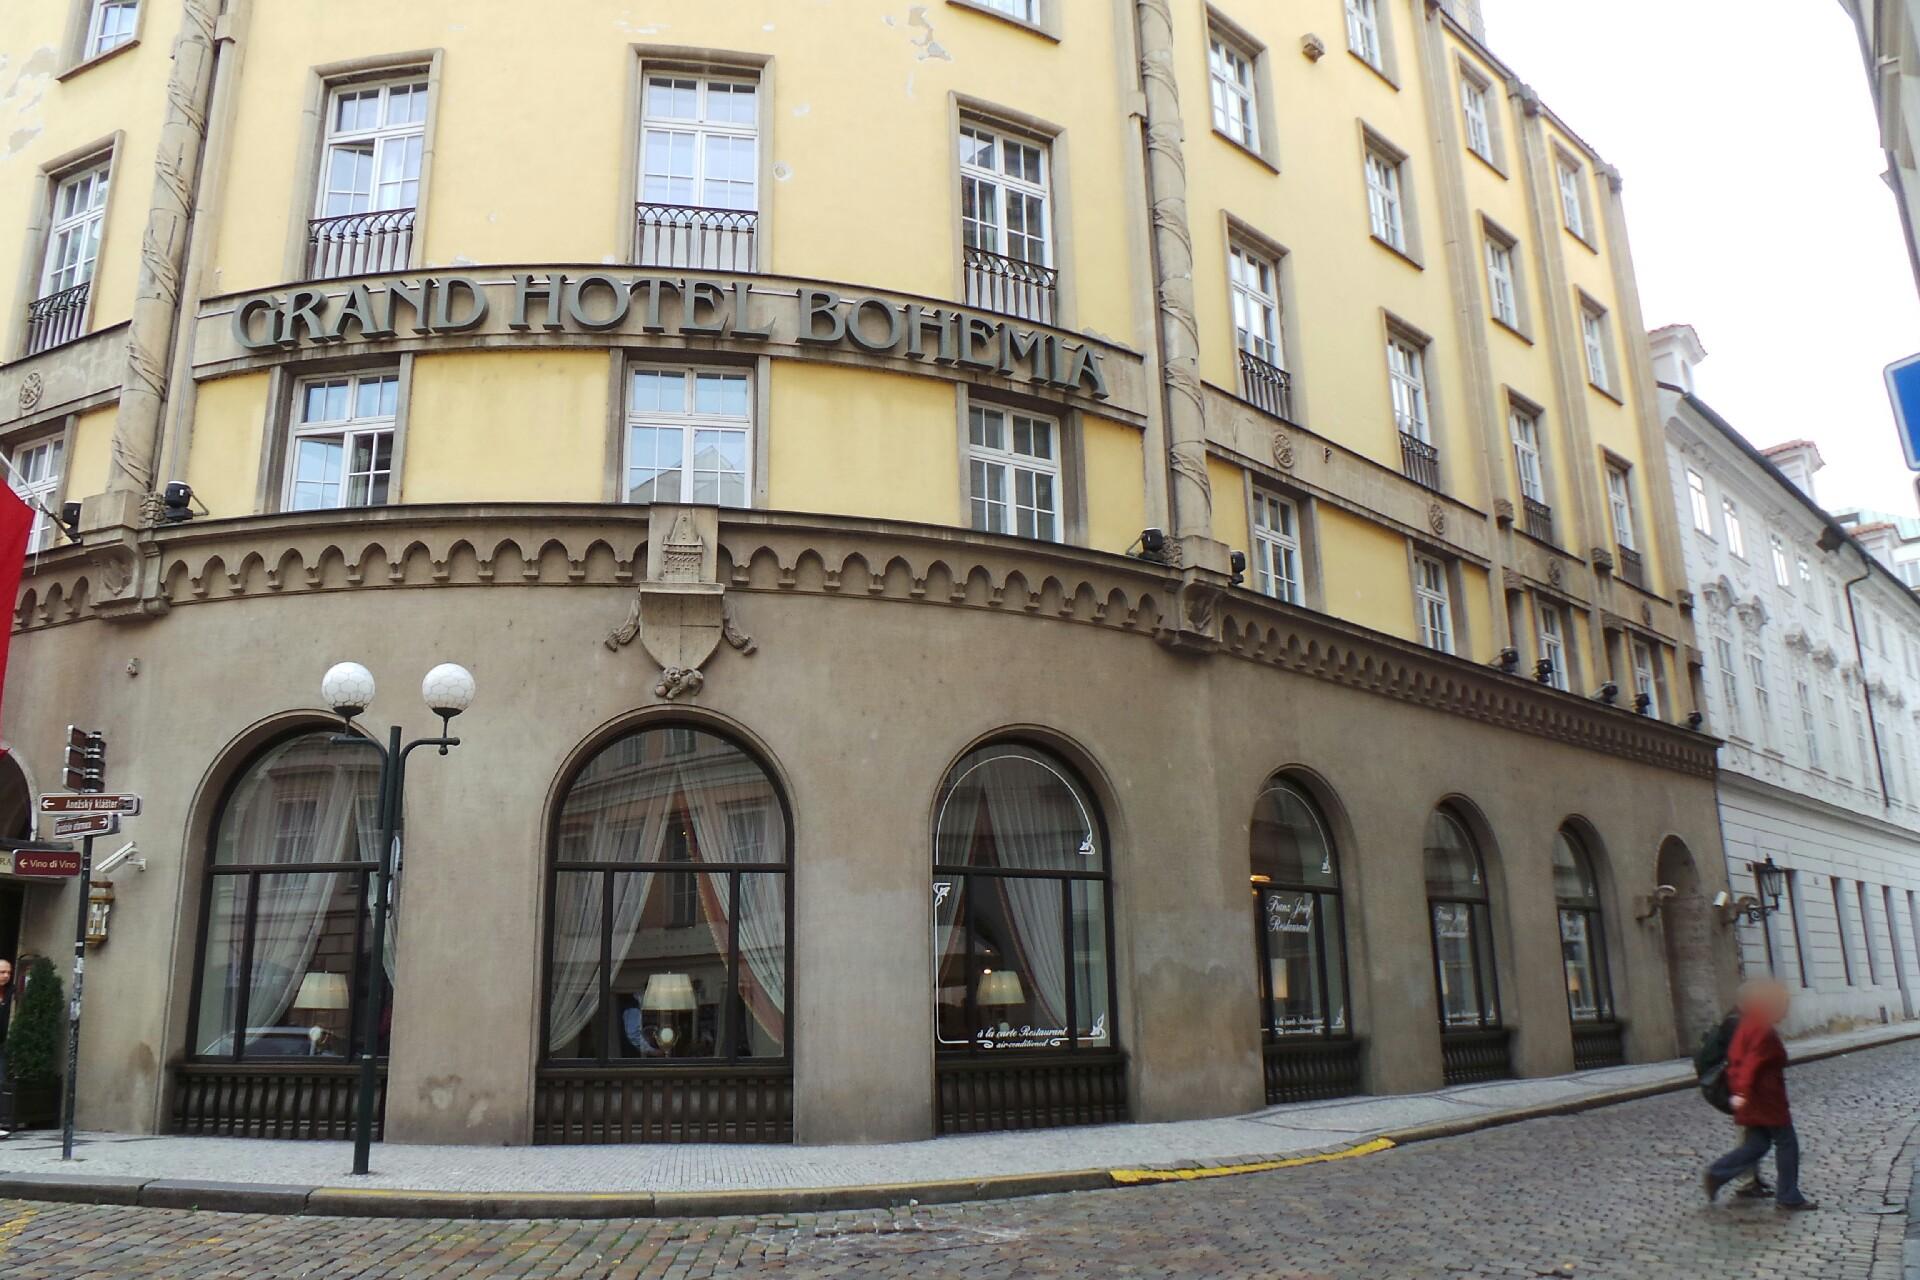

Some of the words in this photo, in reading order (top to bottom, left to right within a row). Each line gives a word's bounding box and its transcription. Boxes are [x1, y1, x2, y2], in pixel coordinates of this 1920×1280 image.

[232, 276, 490, 351] GRAND
[508, 273, 777, 341] HOTEL
[795, 287, 1109, 400] BOHEMIA
[30, 859, 49, 869] Vino
[49, 859, 58, 869] di
[59, 860, 77, 869] Vino
[985, 1026, 995, 1038] la
[996, 1028, 1017, 1039] carte
[1019, 1025, 1067, 1037] Restaurant
